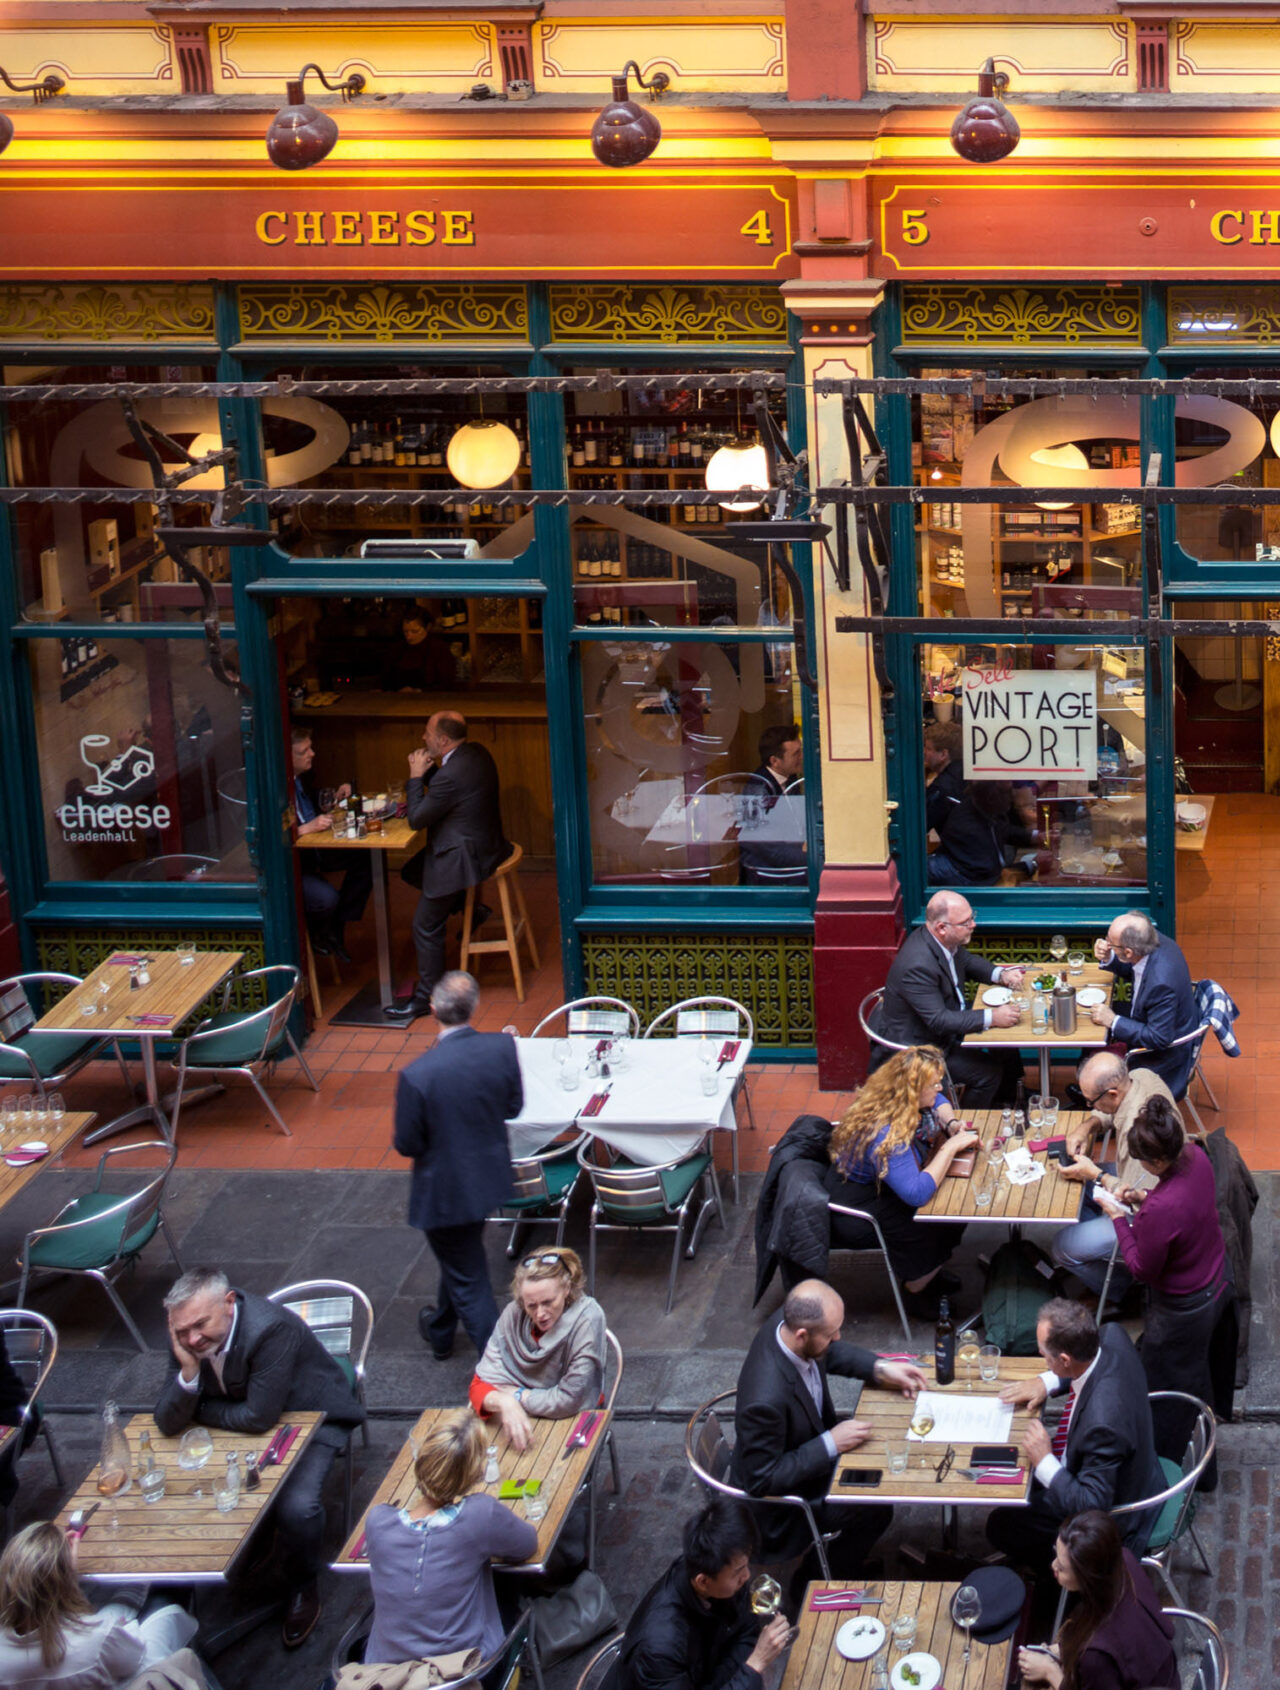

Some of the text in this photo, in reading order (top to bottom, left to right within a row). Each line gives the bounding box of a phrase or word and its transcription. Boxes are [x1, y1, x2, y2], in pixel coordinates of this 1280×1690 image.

[256, 209, 476, 246] CHEESE
[740, 209, 773, 245] 4
[901, 209, 929, 245] 5
[967, 656, 1016, 689] Sell
[964, 689, 1094, 721] VINTAGE
[971, 724, 1092, 768] PORT
[60, 796, 171, 829] cheese
